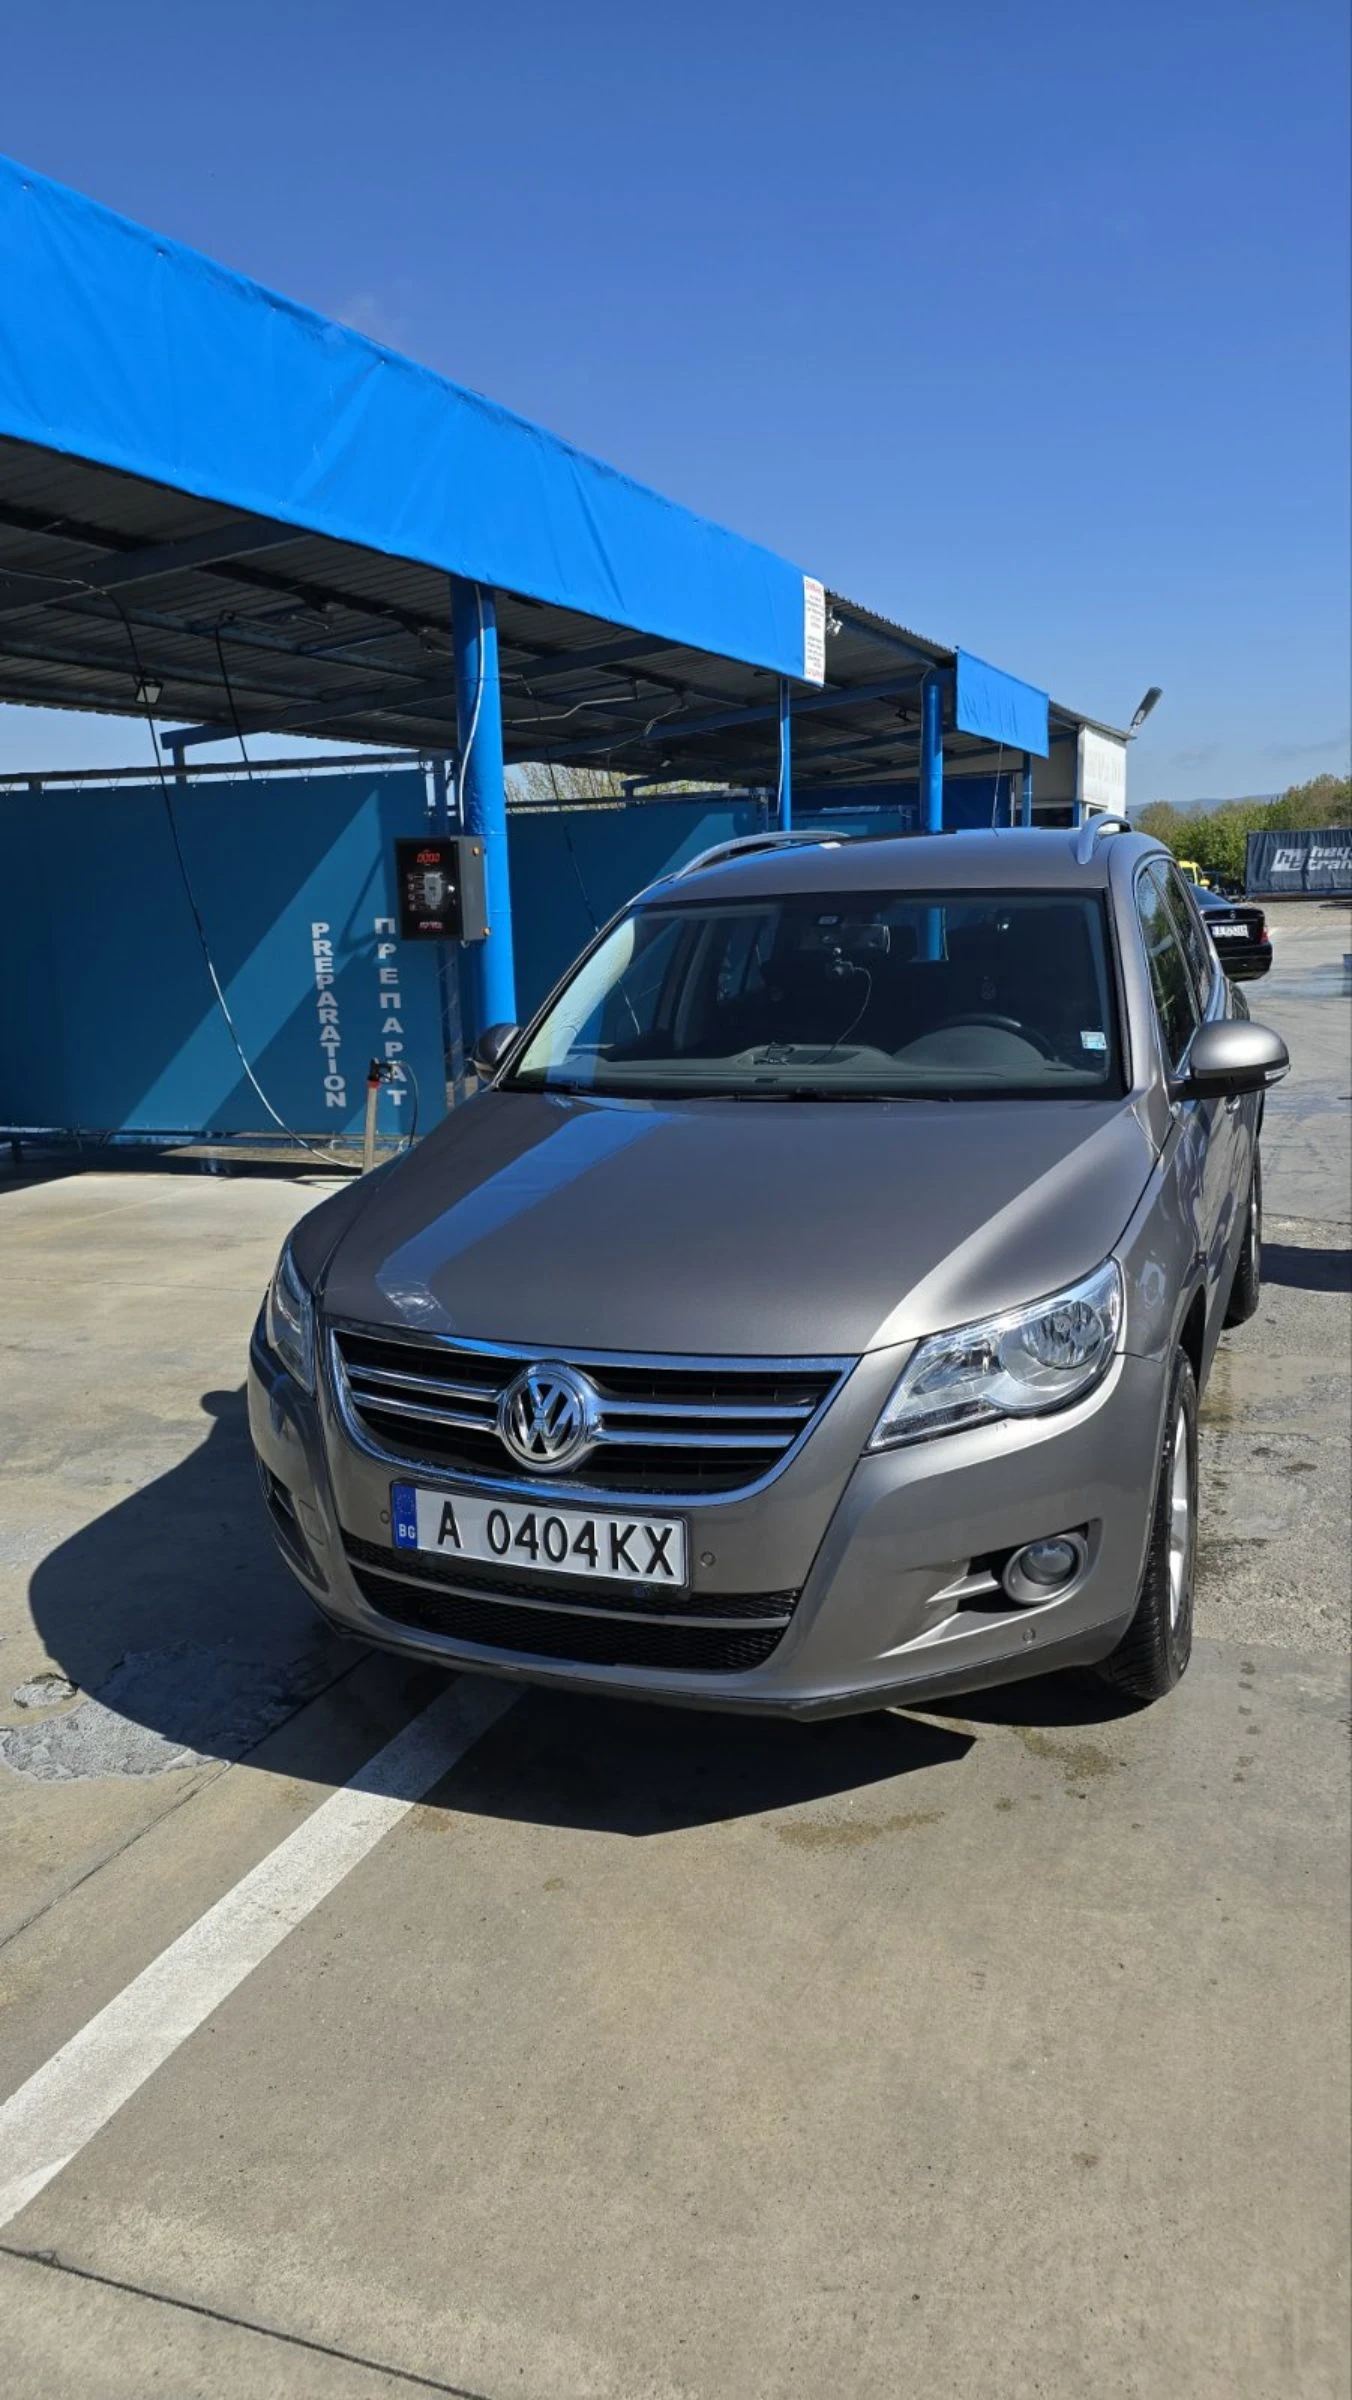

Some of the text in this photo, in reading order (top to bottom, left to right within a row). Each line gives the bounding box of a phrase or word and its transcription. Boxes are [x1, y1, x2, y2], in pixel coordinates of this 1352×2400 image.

[1310, 846, 1352, 860] hey
[311, 922, 346, 1108] PREPARATION
[374, 918, 407, 1106] ПРЕПАРАТ
[399, 1523, 416, 1540] BG
